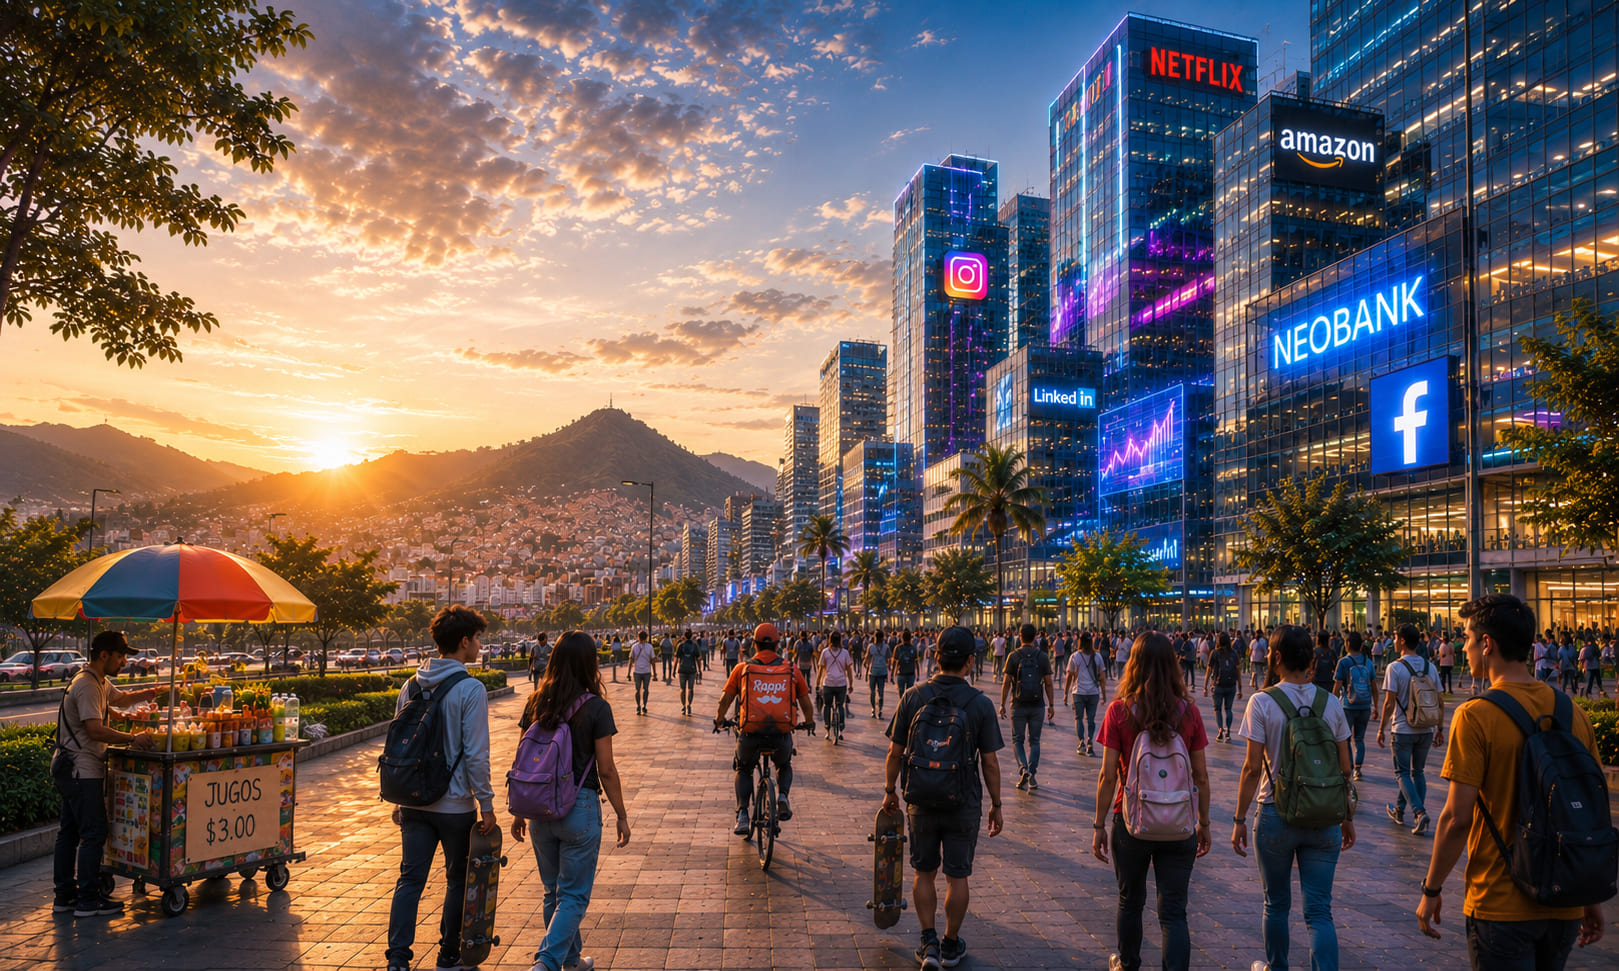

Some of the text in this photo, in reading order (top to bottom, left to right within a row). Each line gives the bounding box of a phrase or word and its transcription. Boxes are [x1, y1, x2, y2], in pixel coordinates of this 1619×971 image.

[1151, 46, 1243, 93] NETFLIX
[1280, 128, 1375, 163] amazon
[1274, 275, 1425, 369] NEOBANK
[1394, 380, 1428, 465] f
[753, 679, 787, 694] Rappi
[204, 778, 262, 808] JUGOS
[206, 814, 255, 846] $3.00
